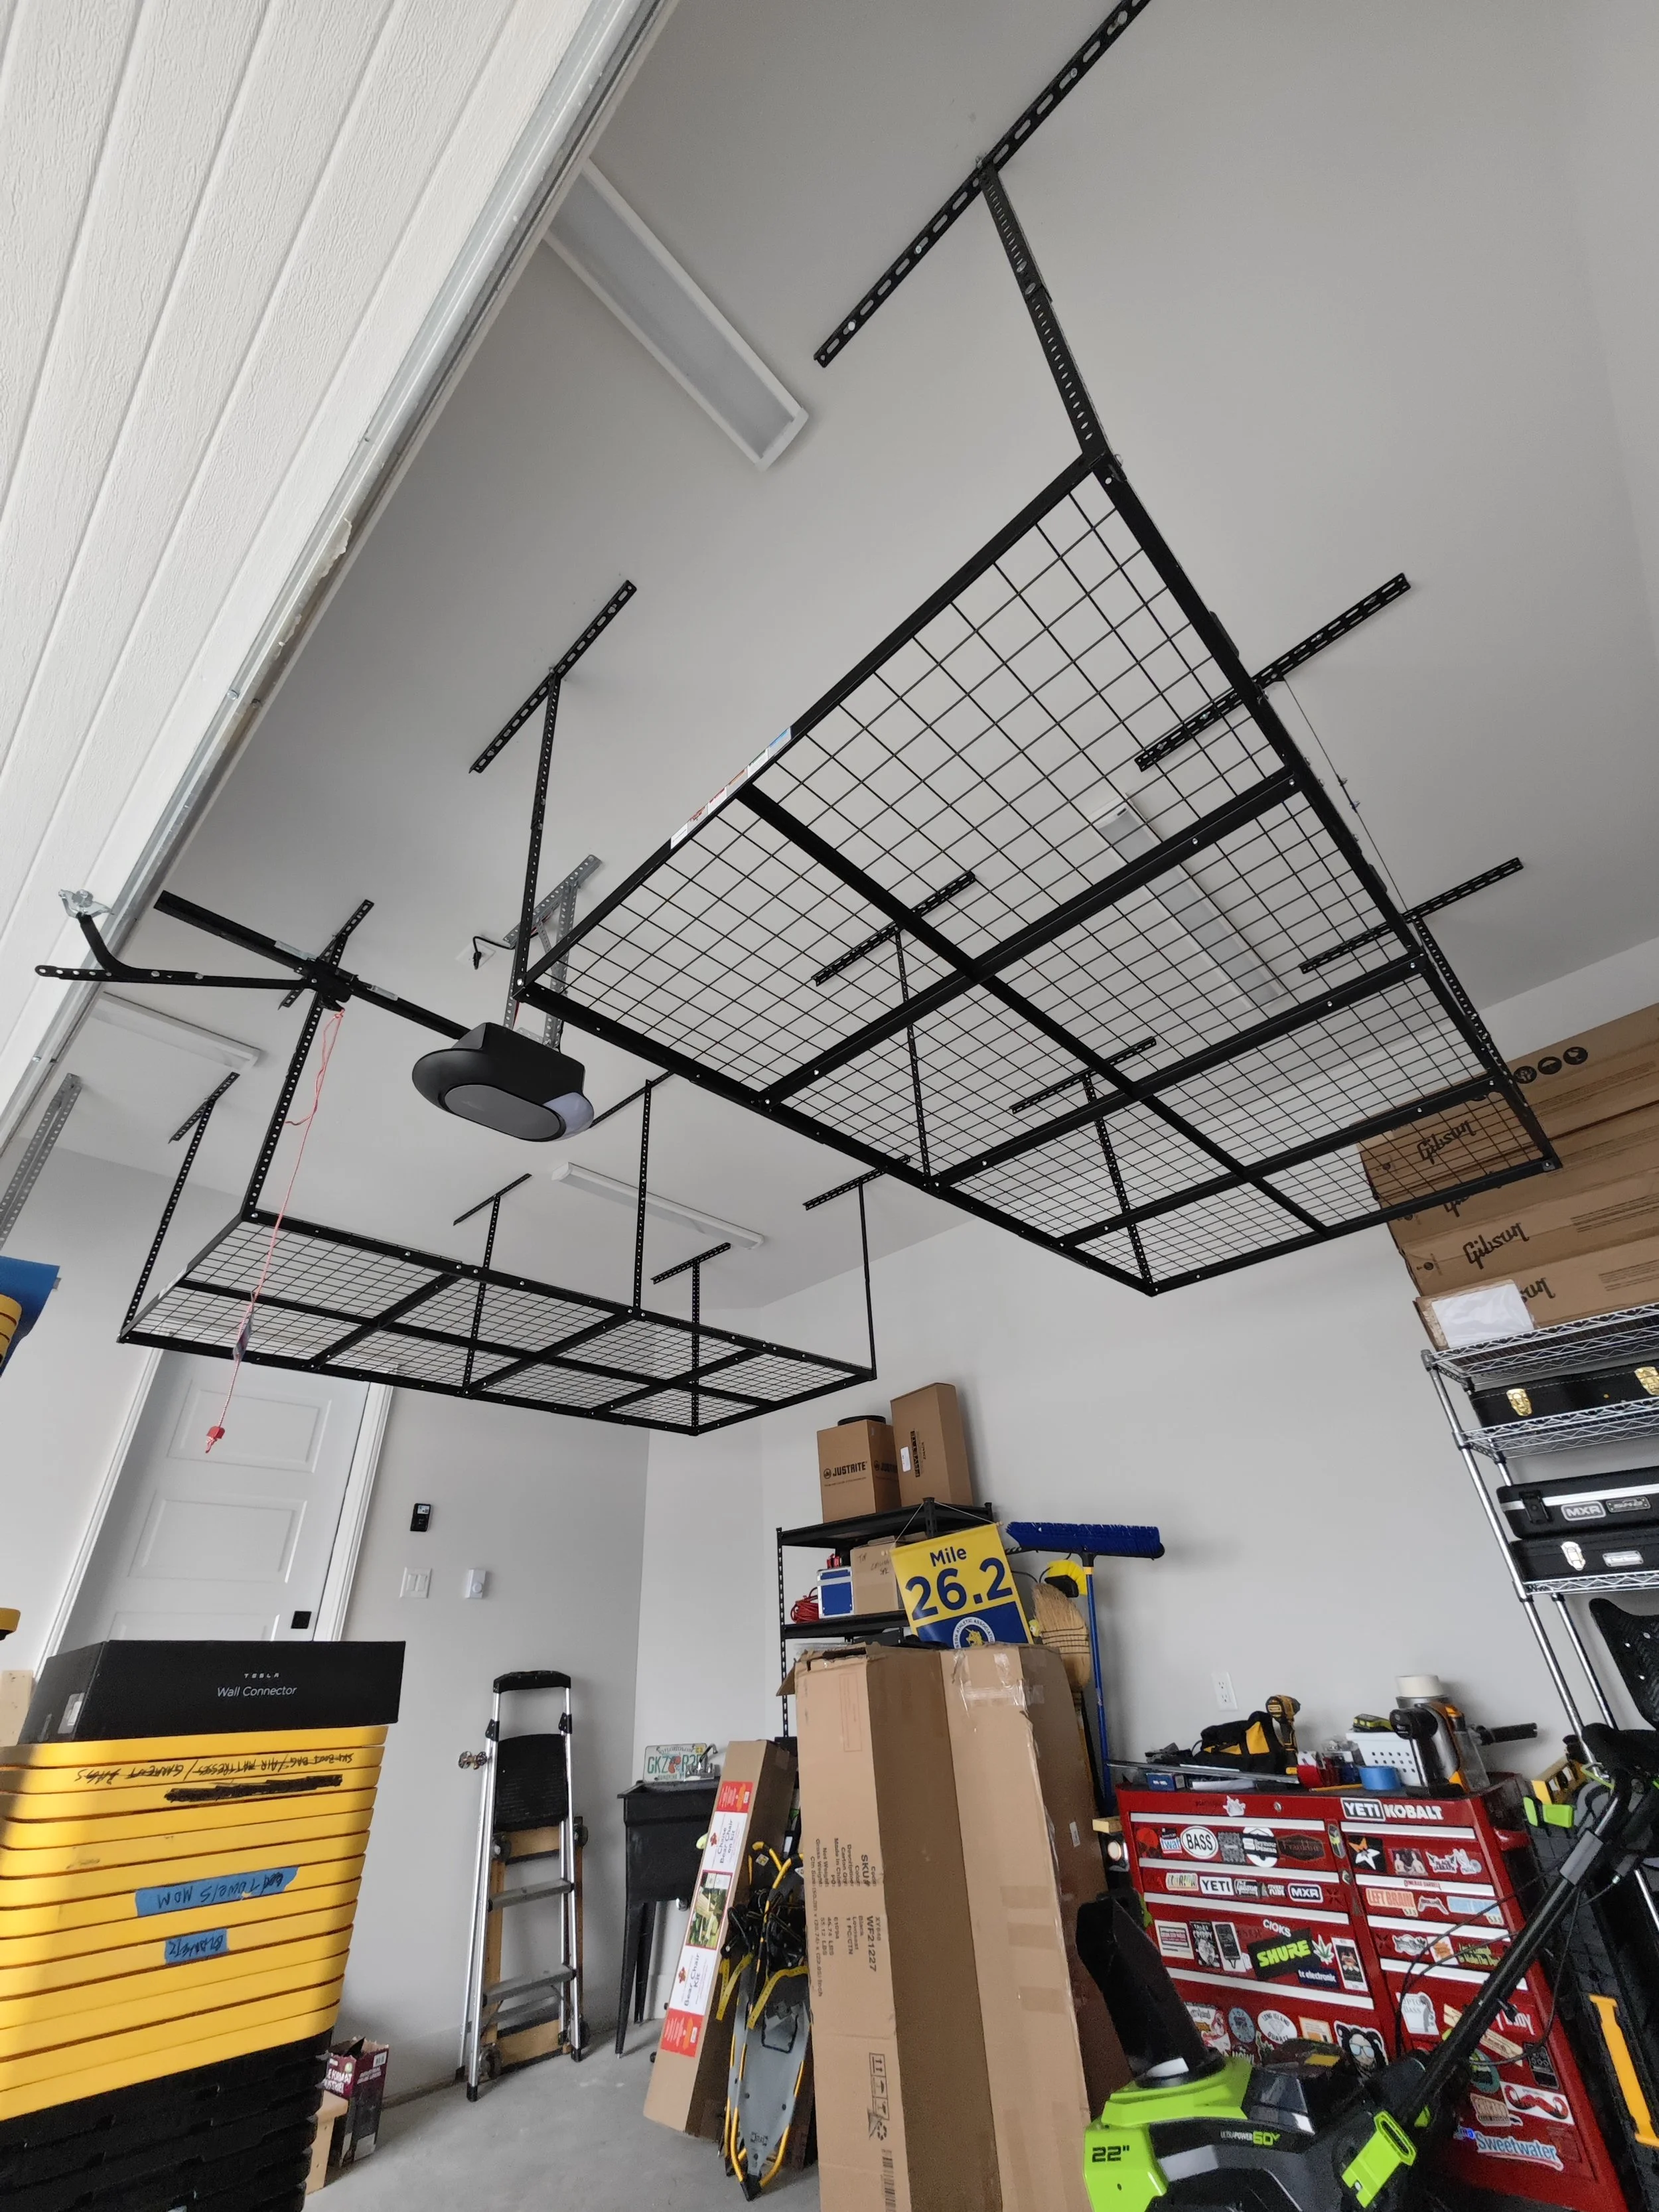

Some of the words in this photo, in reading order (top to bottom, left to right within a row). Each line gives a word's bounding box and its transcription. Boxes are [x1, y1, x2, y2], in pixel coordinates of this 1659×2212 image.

[1463, 1222, 1530, 1270] Gibson
[832, 1461, 866, 1477] JUSTRITE
[1566, 1505, 1601, 1517] MXR
[930, 1546, 967, 1567] Mile
[905, 1557, 1013, 1621] 26.2
[956, 1619, 973, 1633] ATHLETIC
[974, 1619, 993, 1644] ASSOCIATIO
[217, 1686, 240, 1697] Wall
[243, 1686, 297, 1696] Connector
[1344, 1801, 1380, 1817] YETI
[1383, 1804, 1444, 1820] KOBALT
[717, 1827, 727, 1854] Chaise
[1186, 1833, 1213, 1850] BASS
[1202, 1879, 1231, 1892] YETI
[1236, 1880, 1259, 1897] Gibson
[1291, 1887, 1319, 1897] MXR
[1368, 1889, 1385, 1905] LEFT
[1386, 1891, 1414, 1907] BRAIN
[861, 1854, 871, 1887] SKU#
[867, 1916, 877, 1972] WF21227
[1263, 1919, 1292, 1937] CIOKS
[1257, 1940, 1311, 1968] SHURE
[684, 1983, 693, 2006] Bear
[690, 1953, 699, 1979] Chair
[1305, 1970, 1336, 1982] electronic
[1092, 2145, 1130, 2162] 22"
[1476, 2134, 1555, 2161] Sweetwater
